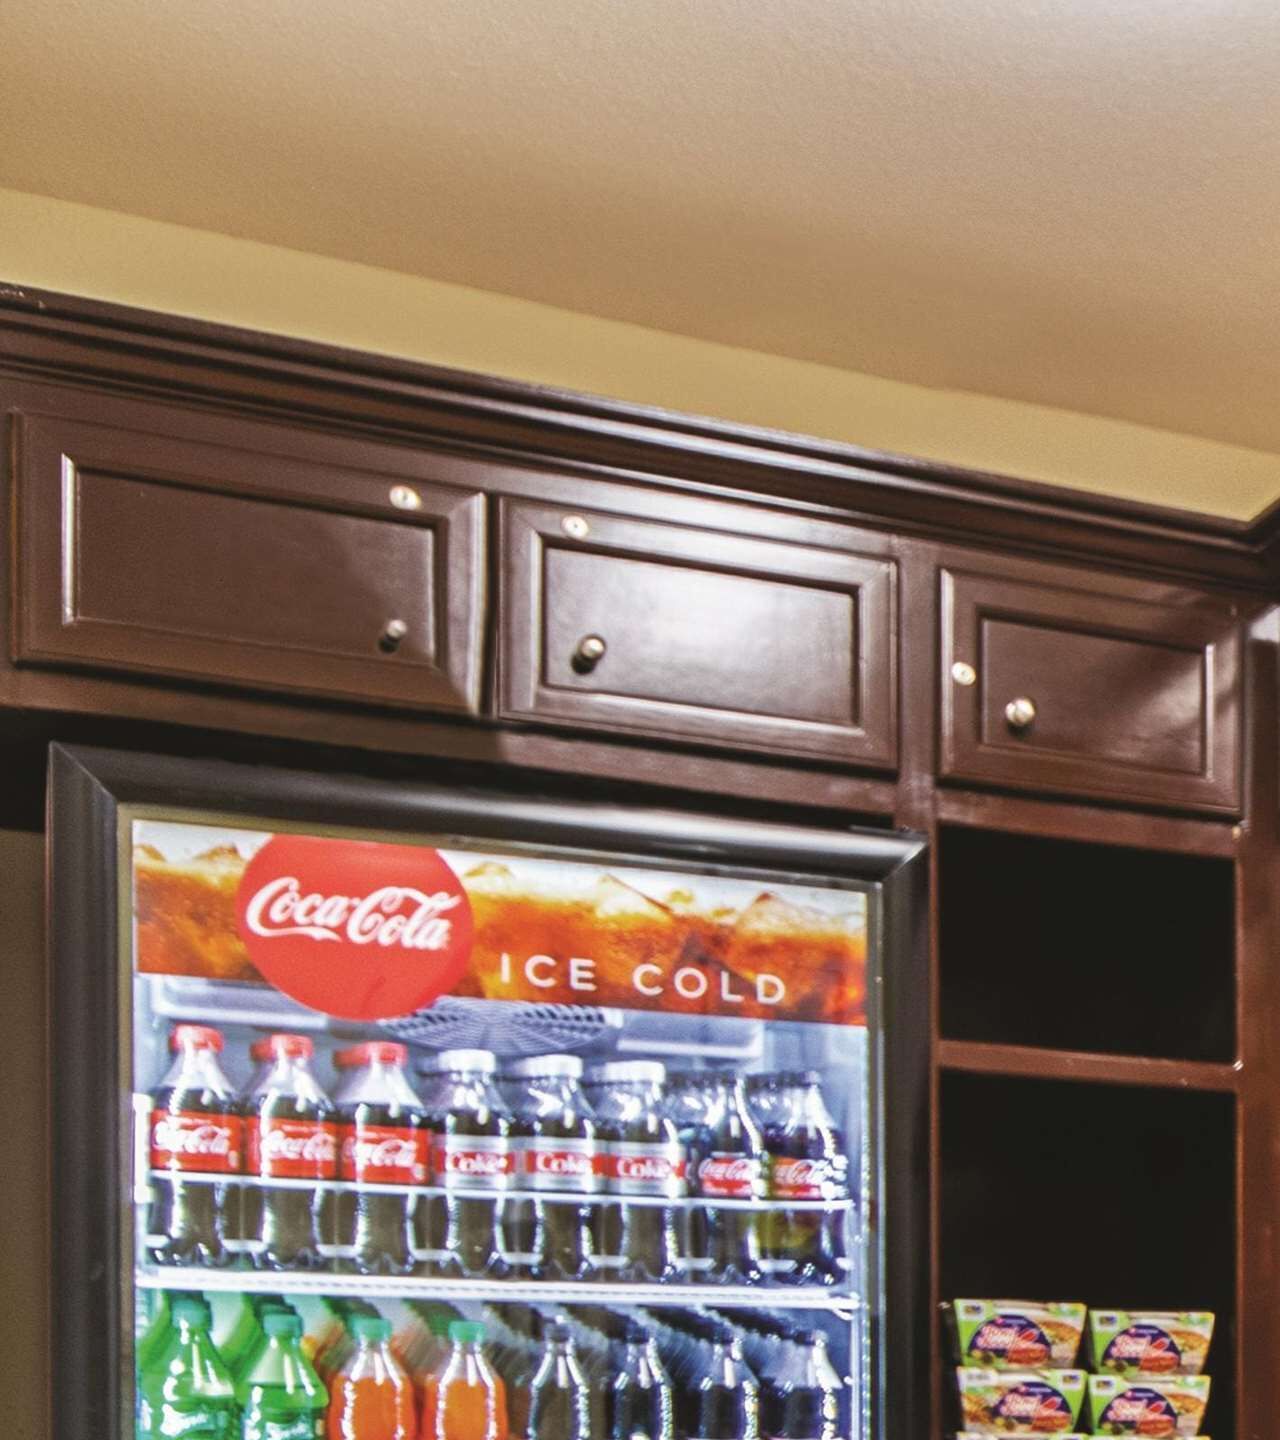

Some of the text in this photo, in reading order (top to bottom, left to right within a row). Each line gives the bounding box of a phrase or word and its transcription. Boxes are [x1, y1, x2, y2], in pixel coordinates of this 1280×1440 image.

[246, 876, 461, 951] Coca-Cola
[500, 952, 787, 1005] ICE COLD
